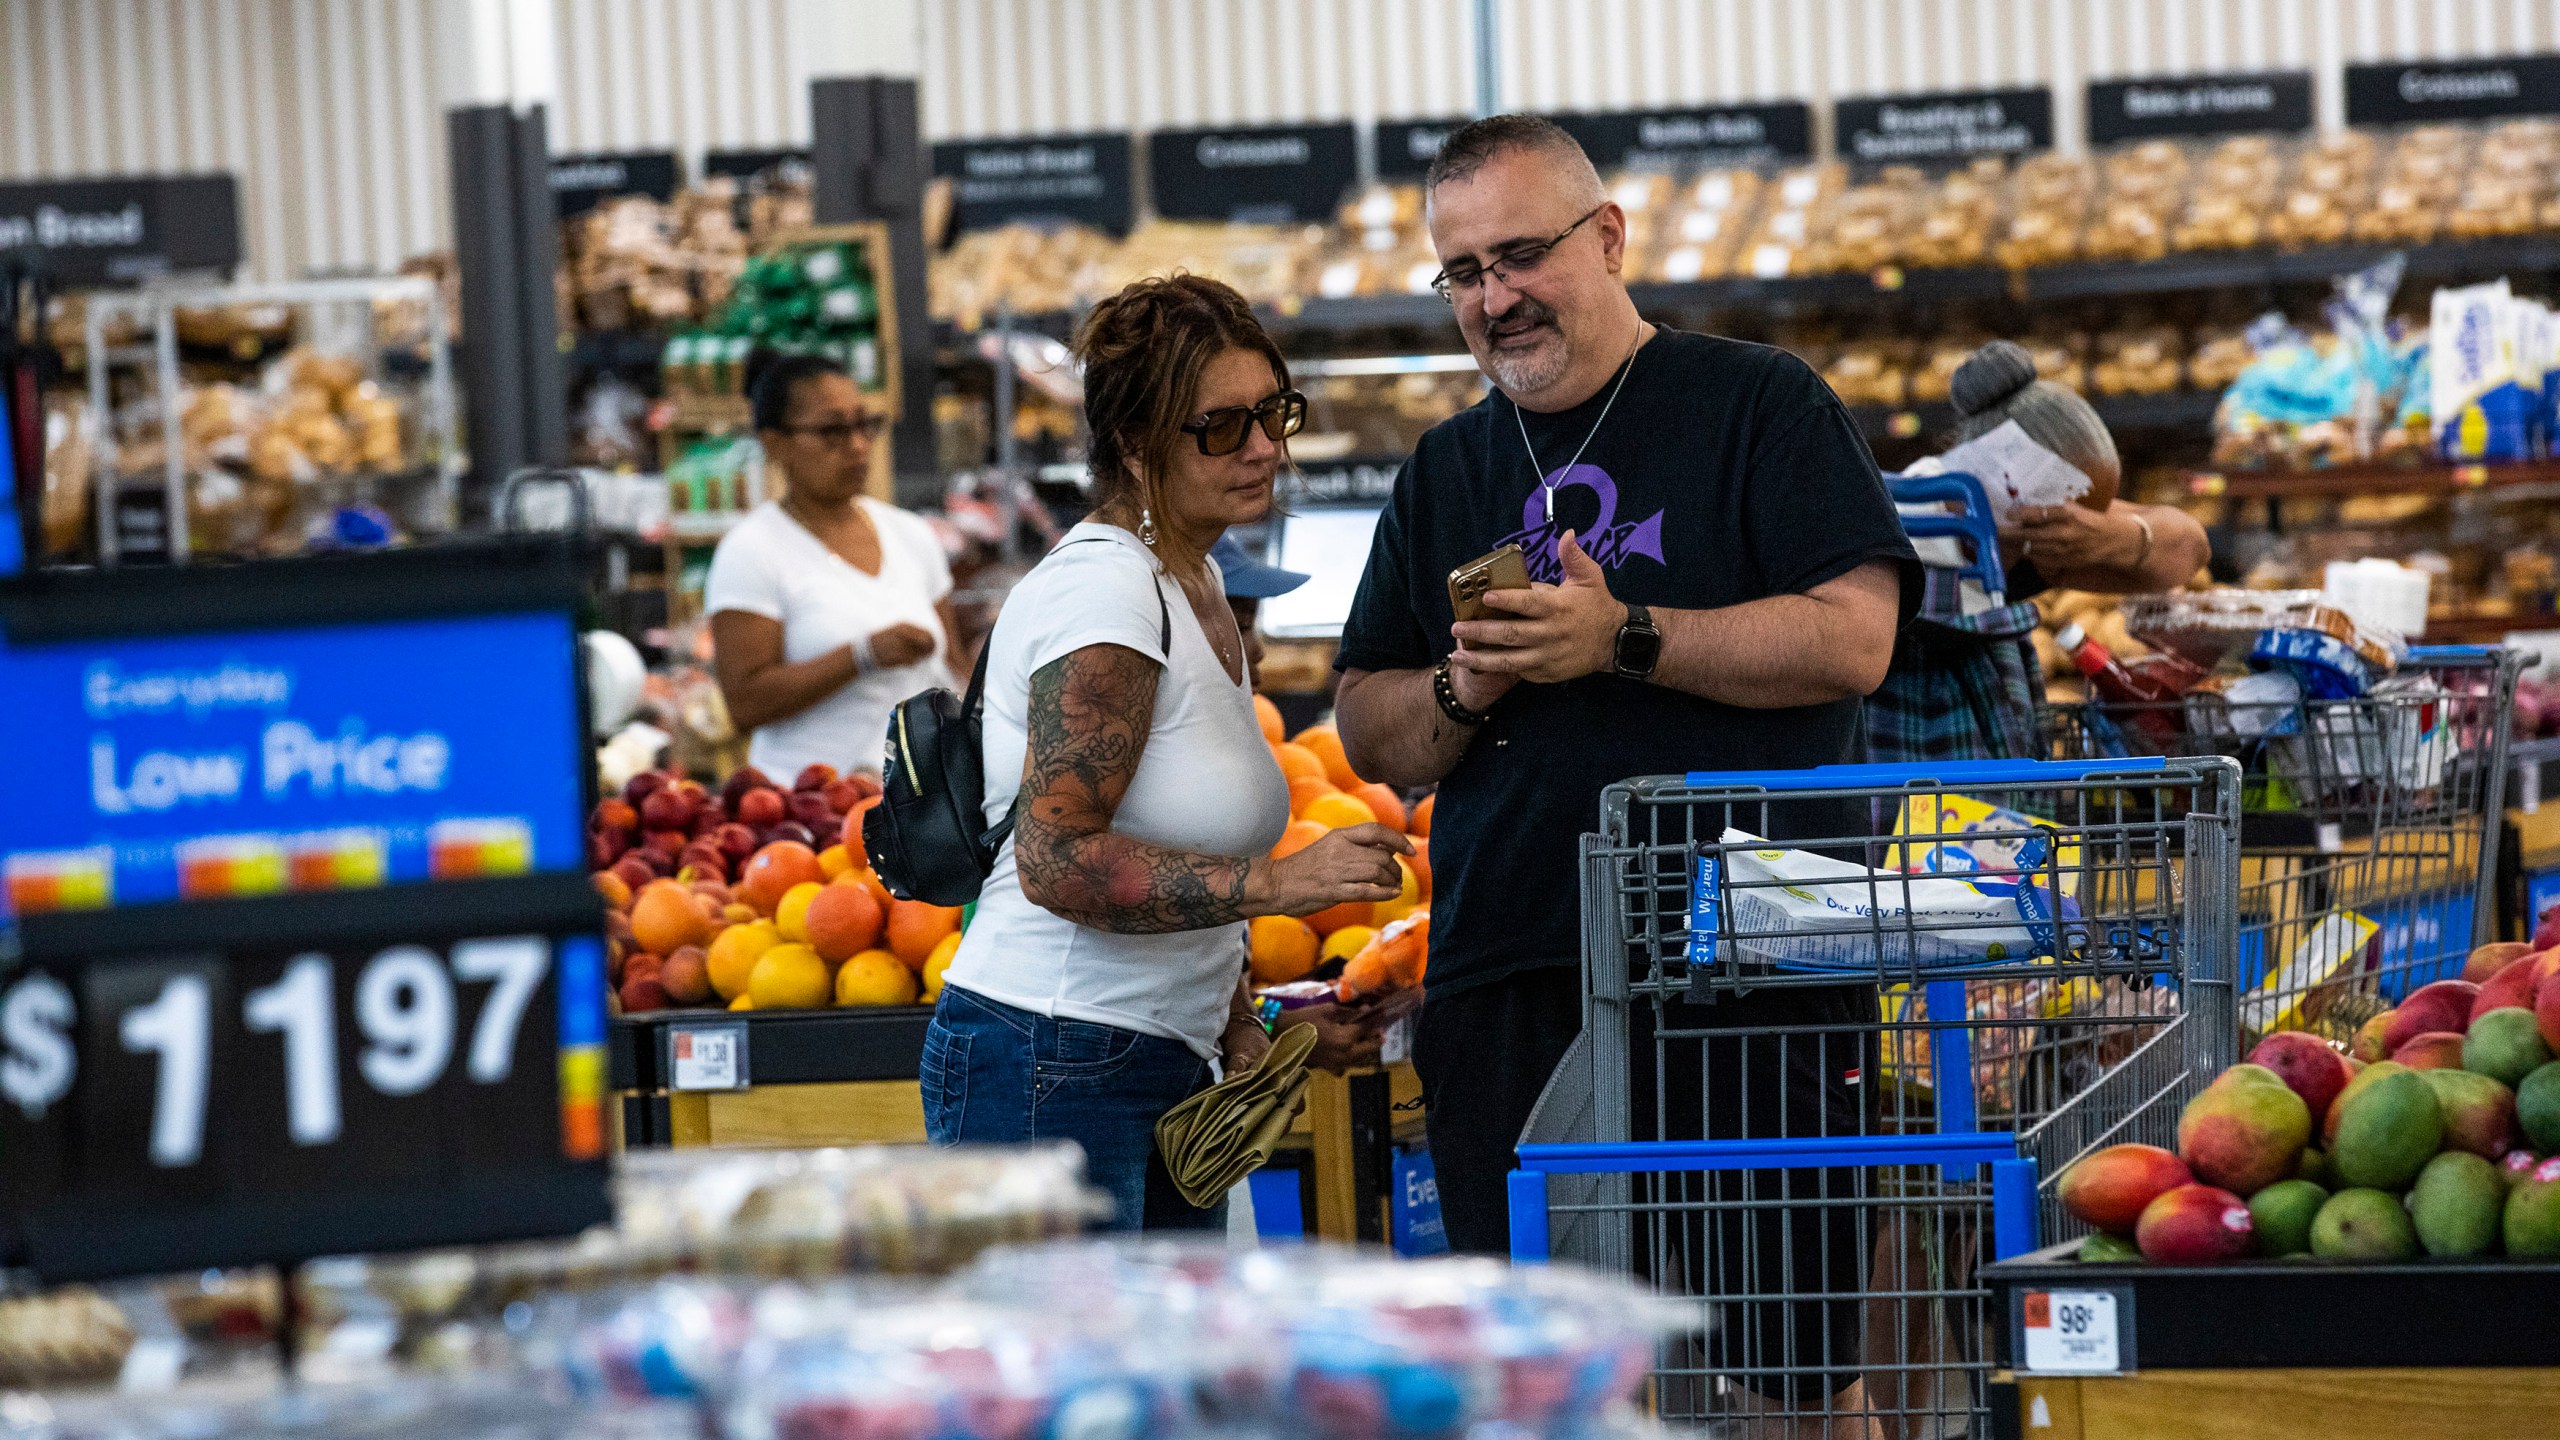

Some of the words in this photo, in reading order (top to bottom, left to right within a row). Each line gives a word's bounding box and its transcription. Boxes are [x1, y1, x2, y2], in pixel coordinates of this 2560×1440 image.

[86, 656, 290, 721] Everyday
[90, 736, 244, 813] Low
[261, 718, 452, 796] Price
